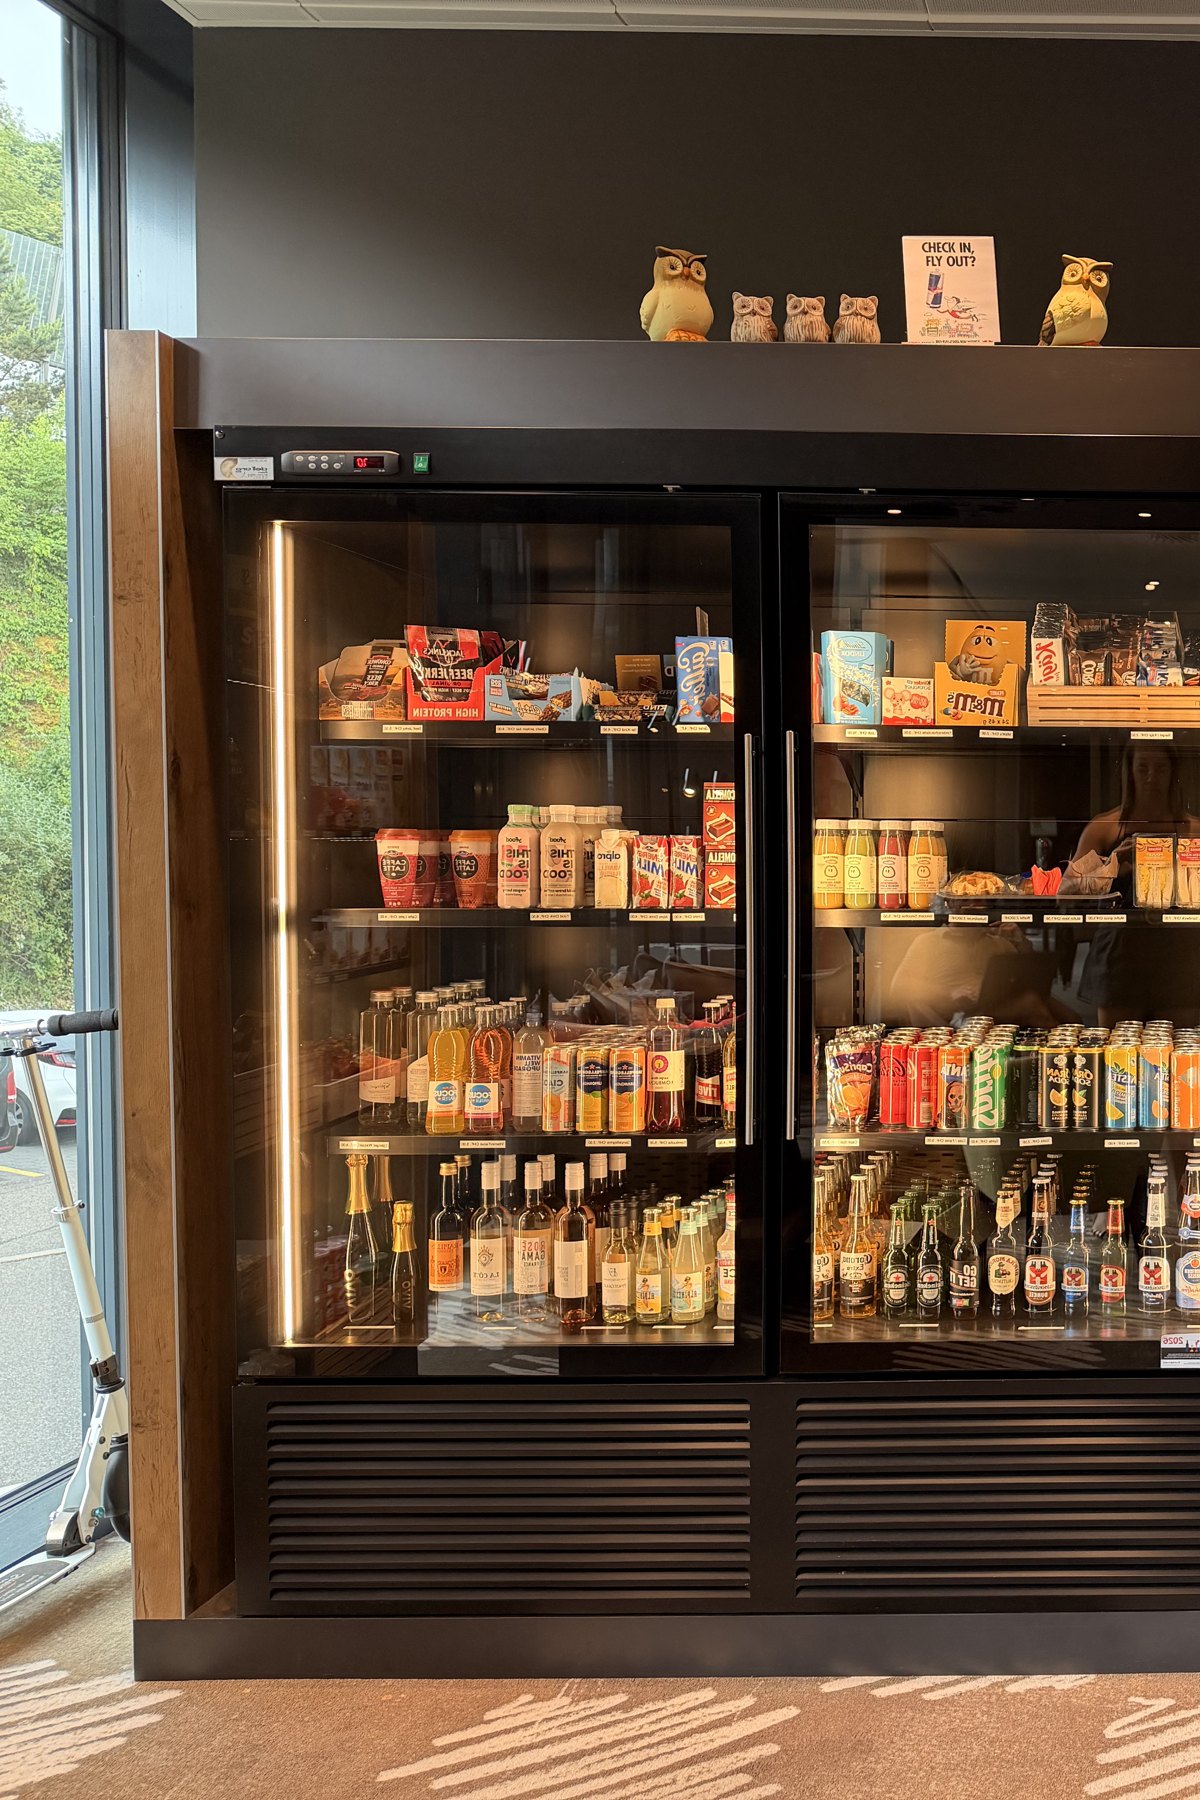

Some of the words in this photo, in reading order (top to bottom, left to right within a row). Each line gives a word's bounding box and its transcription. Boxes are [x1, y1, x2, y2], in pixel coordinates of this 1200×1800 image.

[922, 242, 956, 253] CHECK
[960, 242, 975, 254] IN,
[926, 256, 943, 267] FLY
[947, 256, 976, 267] OUT?
